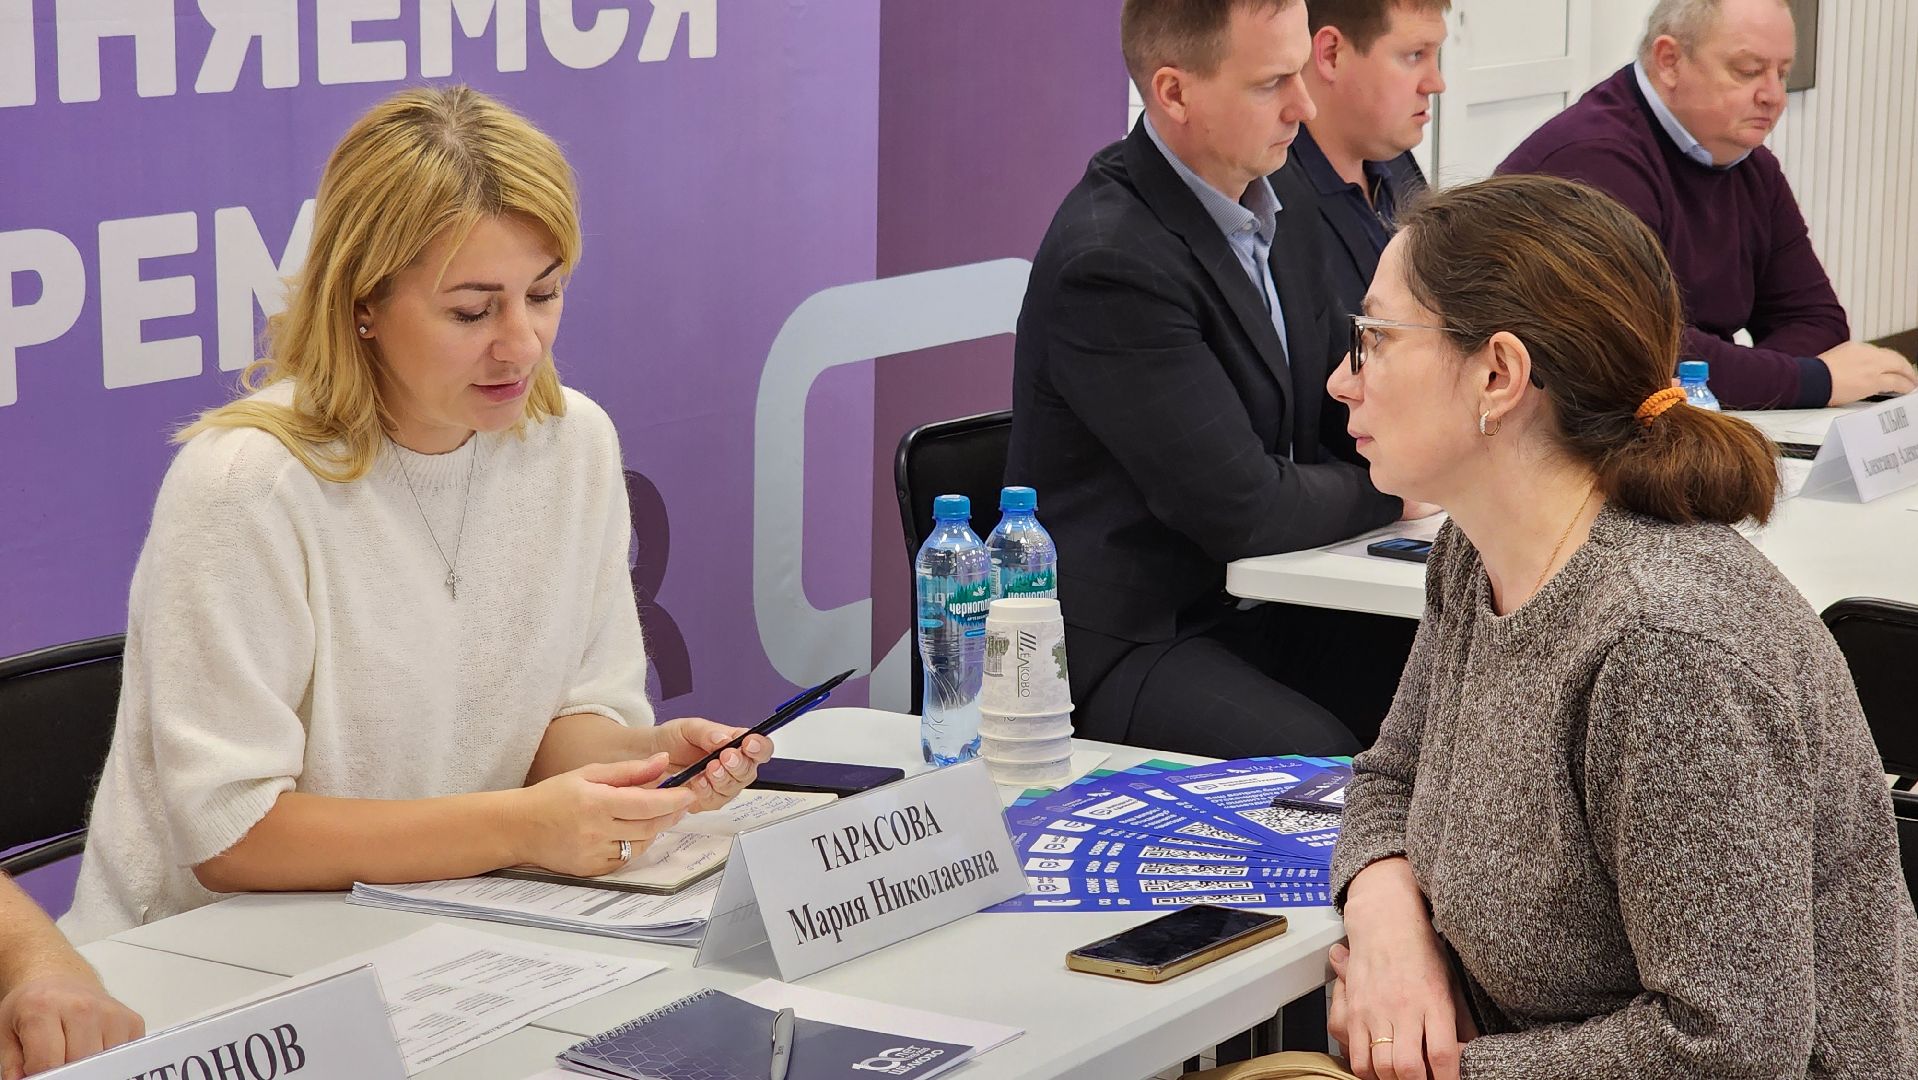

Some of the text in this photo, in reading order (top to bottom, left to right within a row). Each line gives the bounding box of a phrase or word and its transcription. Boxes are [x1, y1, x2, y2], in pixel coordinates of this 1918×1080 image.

[0, 0, 718, 107] НЯЕМСЯ
[812, 801, 943, 872] ТАРАСОВА
[786, 892, 870, 945] Мария
[868, 849, 1000, 916] Николаевна
